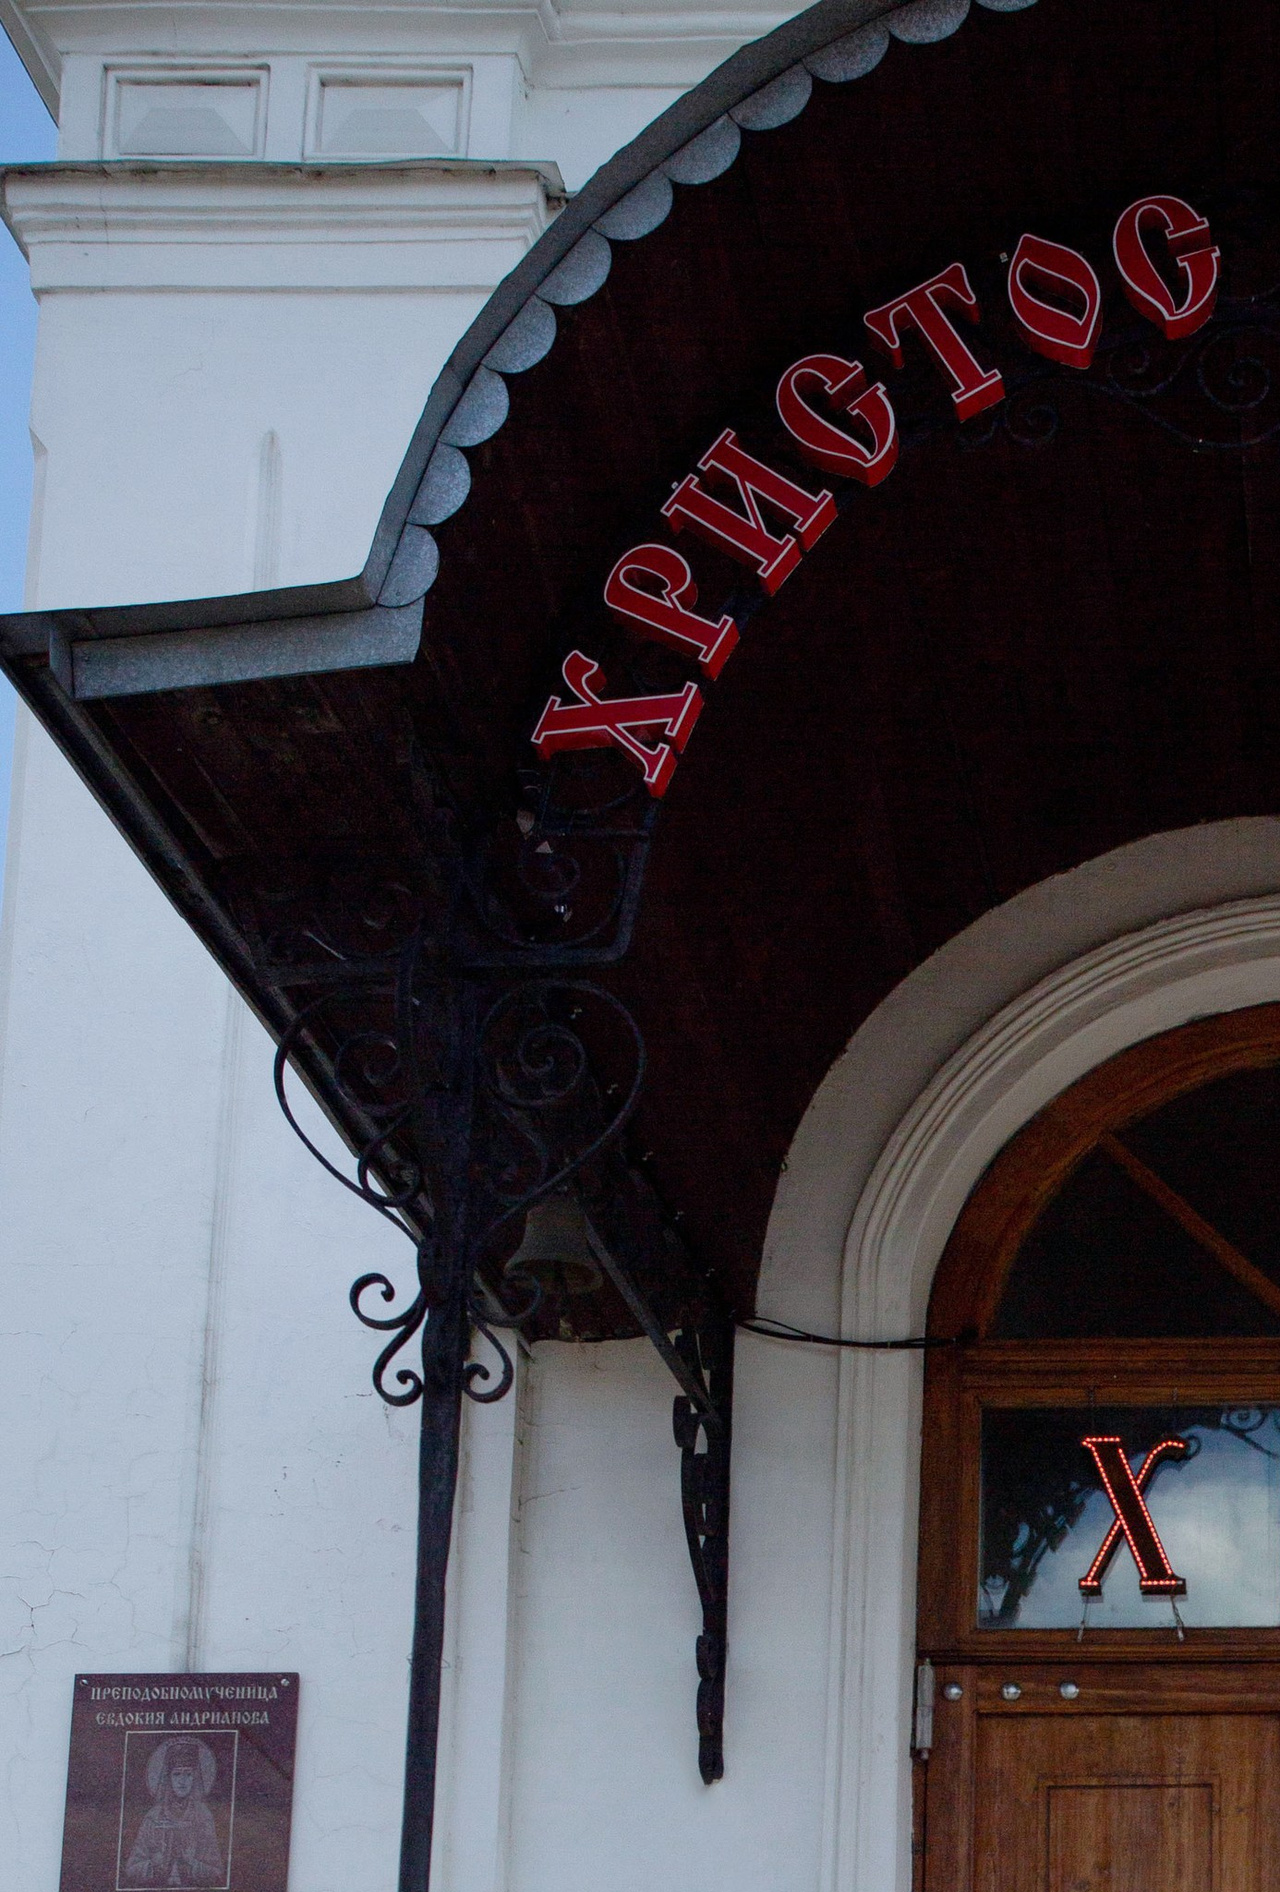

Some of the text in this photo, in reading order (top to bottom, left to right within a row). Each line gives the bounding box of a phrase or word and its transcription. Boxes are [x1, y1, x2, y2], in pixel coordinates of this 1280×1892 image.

[531, 195, 1221, 797] ХРИСТОС
[91, 1686, 278, 1703] ПРЕПОДОБНОМУЧЕНИЦА
[170, 1711, 269, 1725] АНДРИАНОВА
